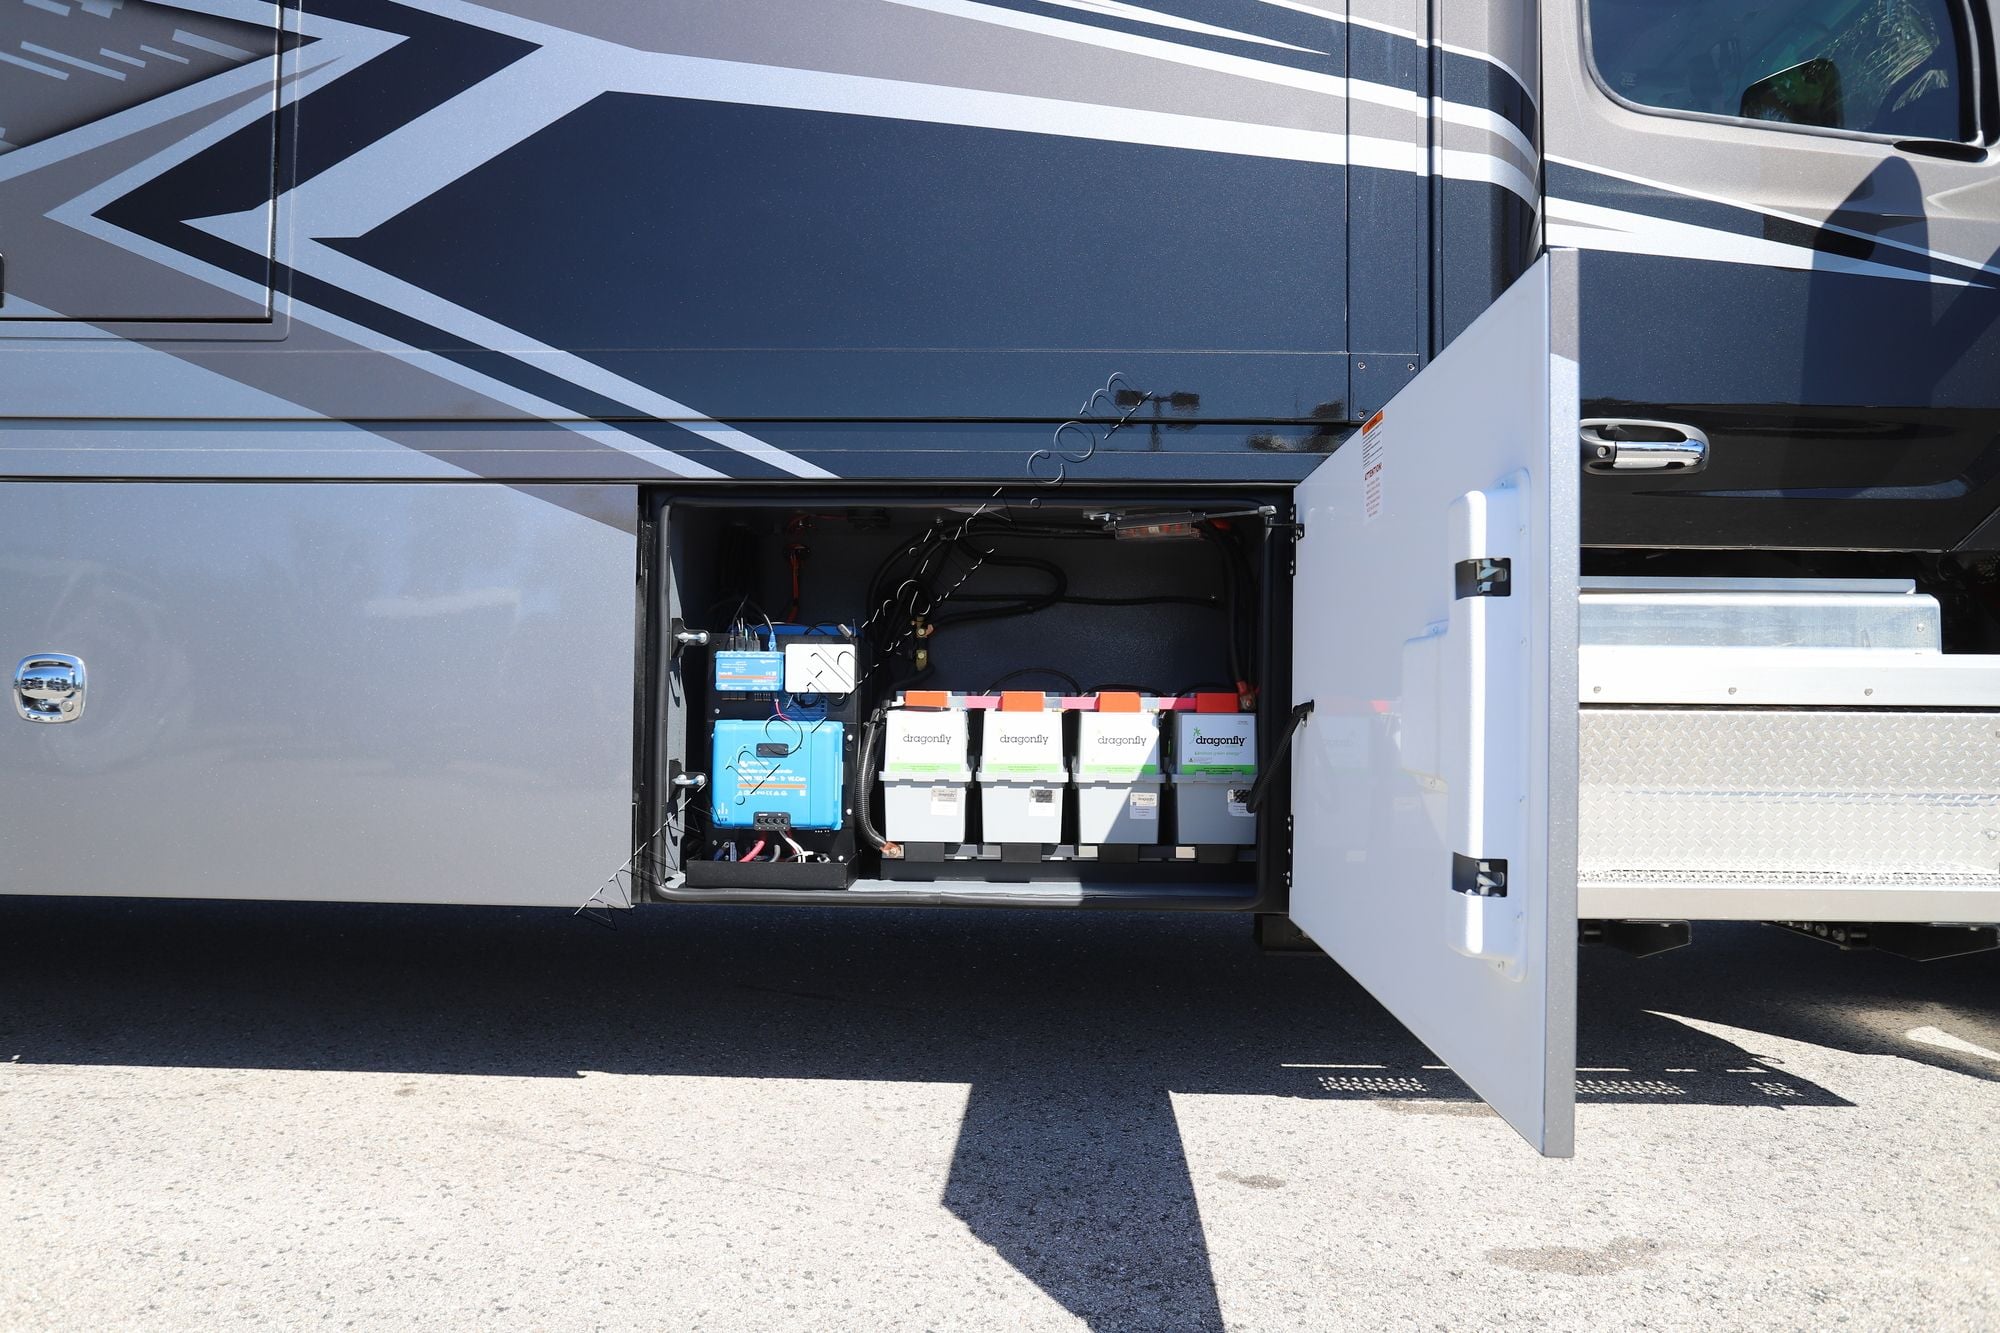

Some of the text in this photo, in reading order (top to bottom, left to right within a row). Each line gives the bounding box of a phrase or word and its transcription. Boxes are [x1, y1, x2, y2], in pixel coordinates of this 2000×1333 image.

[903, 734, 952, 745] dragonfly
[1000, 735, 1049, 746] dragonfly
[1097, 736, 1147, 747] dragonfly
[1195, 735, 1246, 747] dragonfly
